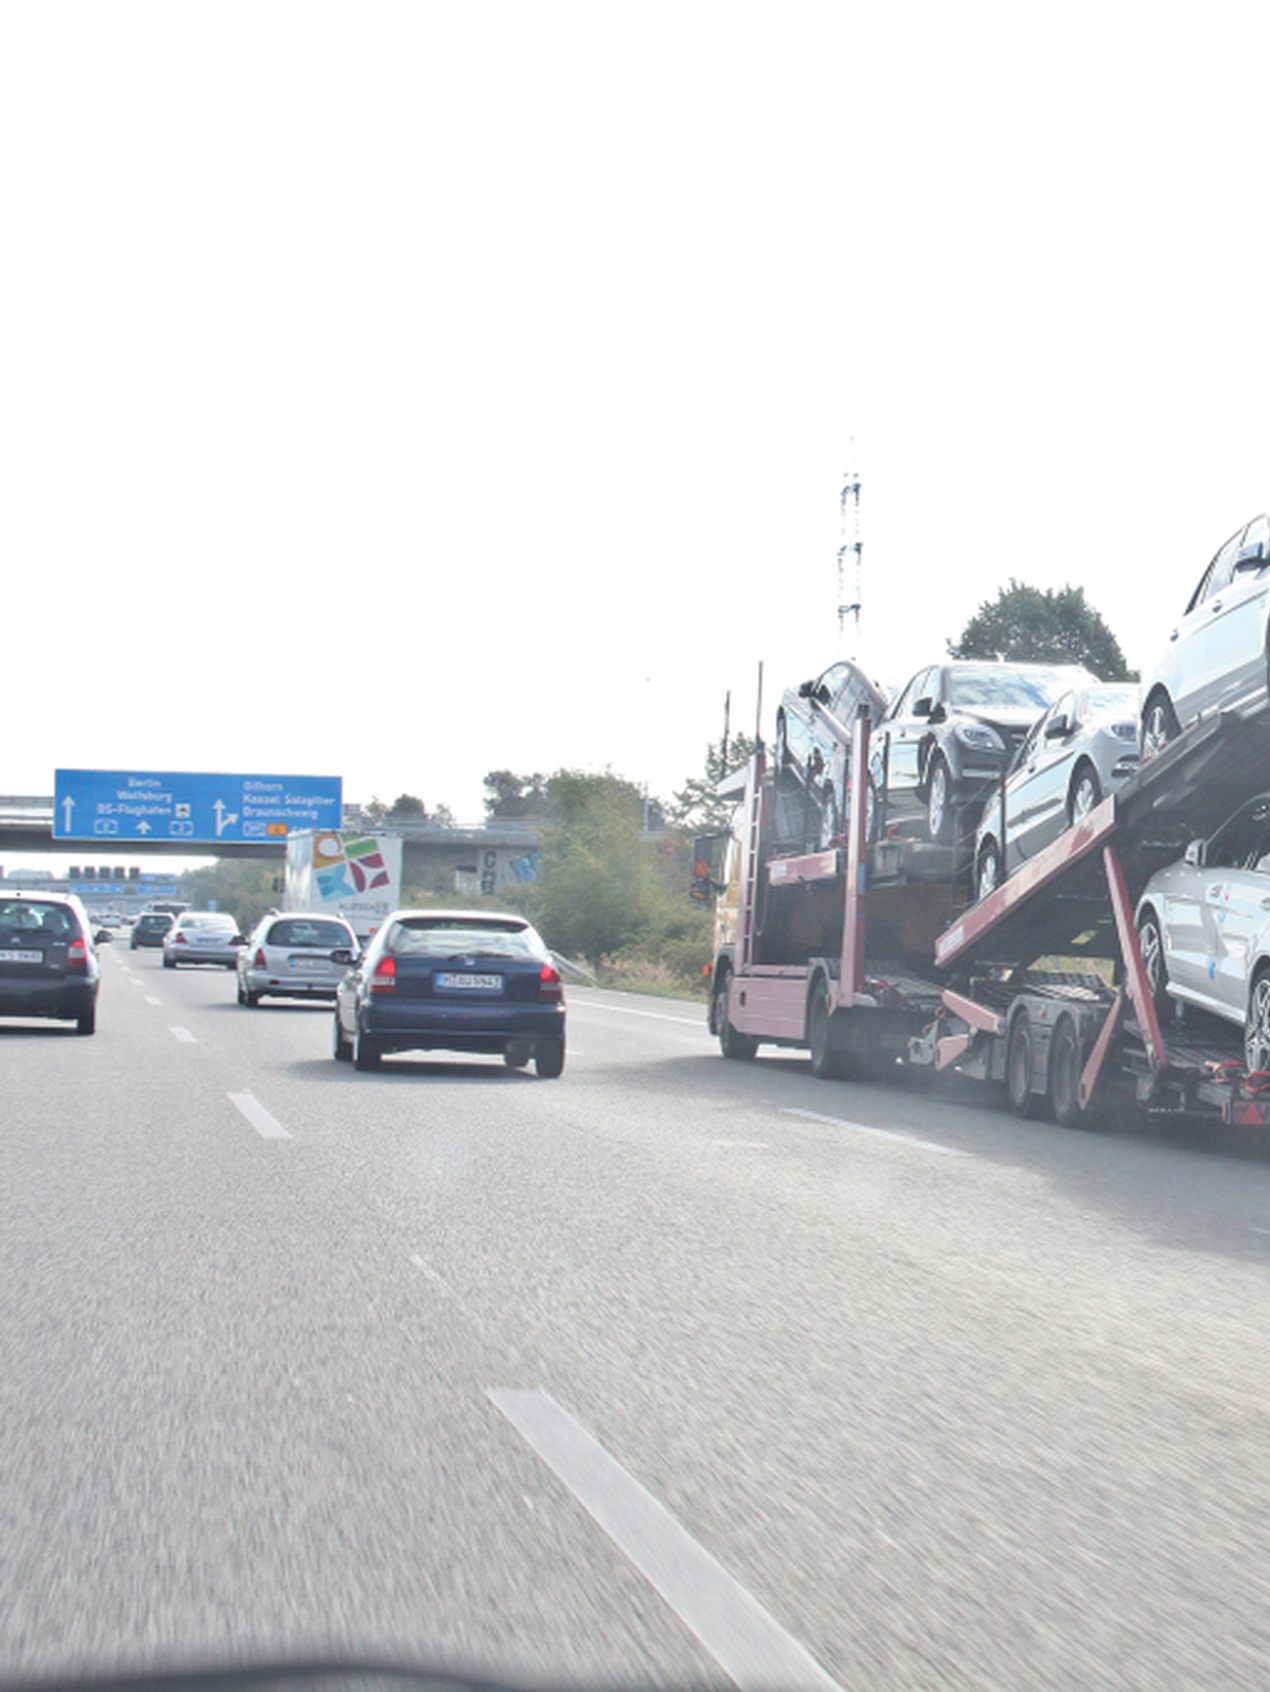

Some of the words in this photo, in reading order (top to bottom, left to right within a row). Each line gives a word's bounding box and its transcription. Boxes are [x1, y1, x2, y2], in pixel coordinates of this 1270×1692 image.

[128, 777, 162, 788] Berlin
[242, 780, 284, 792] Gifhorn
[115, 790, 173, 804] Wolfsburg
[284, 794, 336, 806] Salzgitter
[242, 806, 319, 820] Braunschweig
